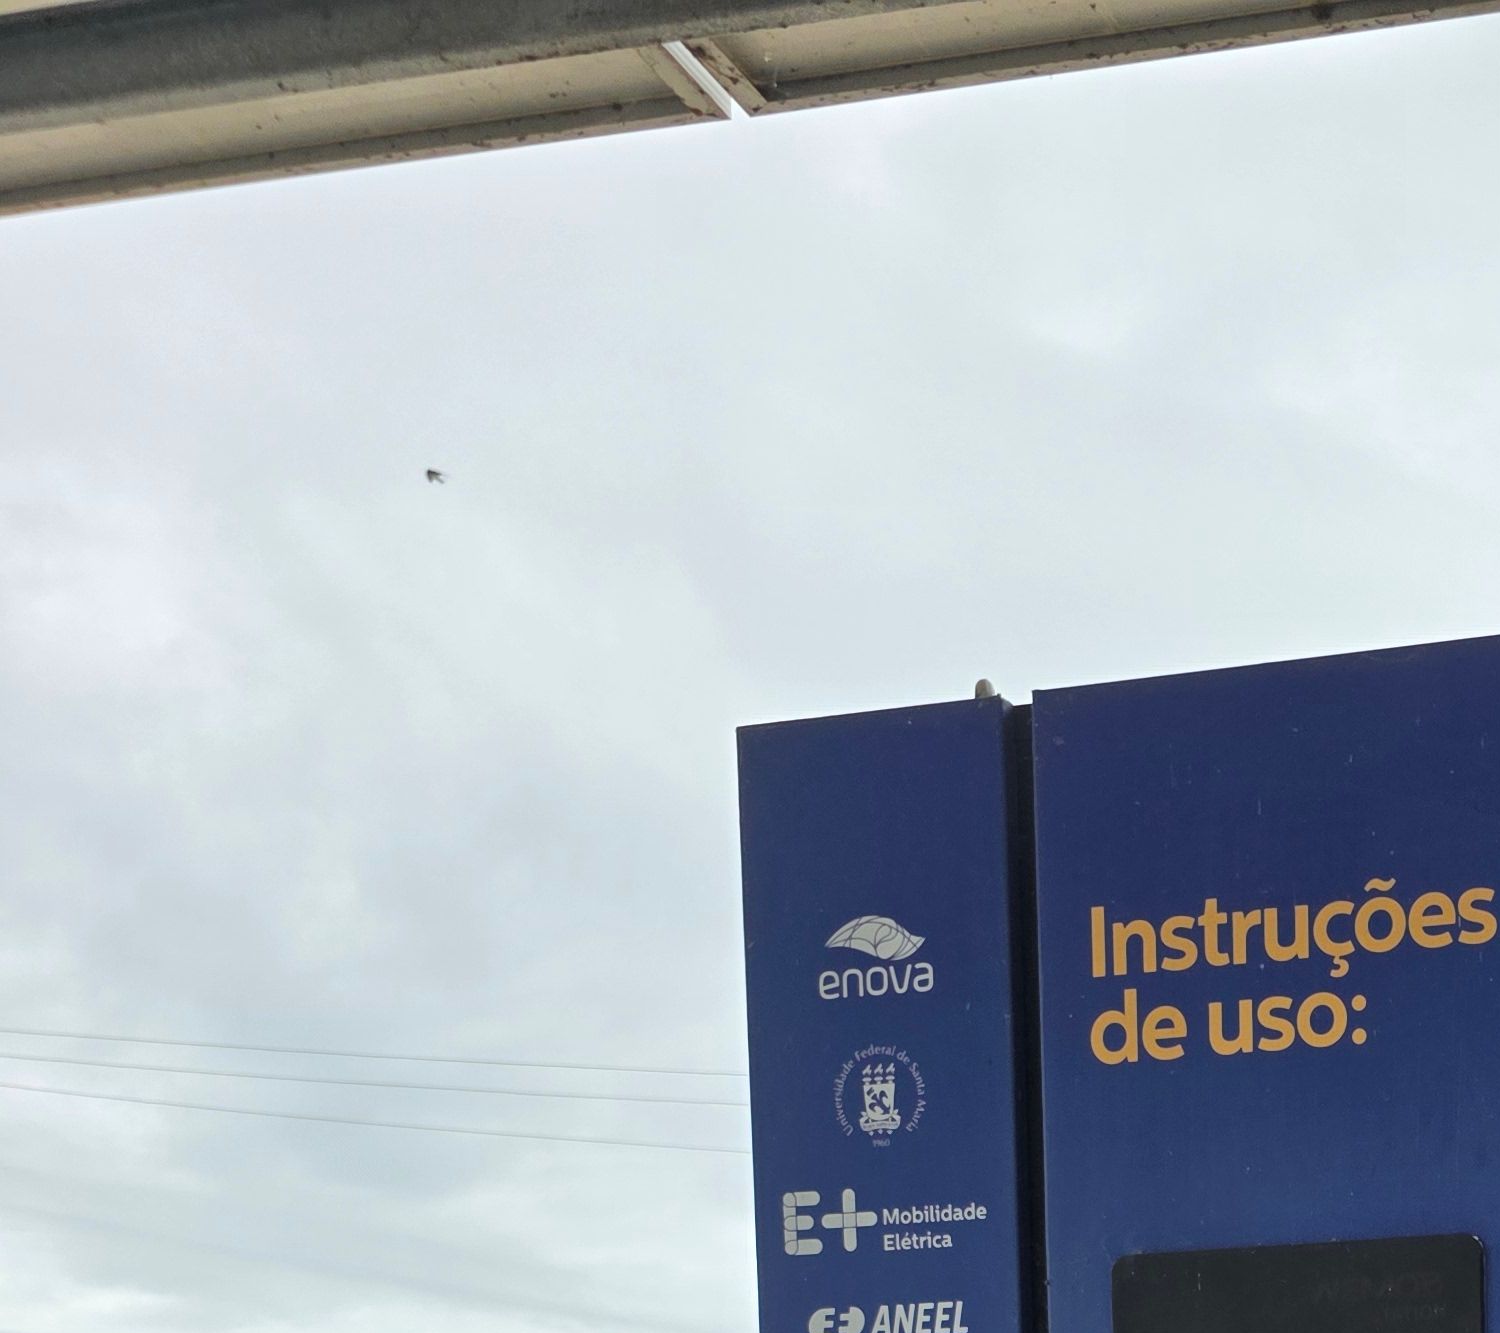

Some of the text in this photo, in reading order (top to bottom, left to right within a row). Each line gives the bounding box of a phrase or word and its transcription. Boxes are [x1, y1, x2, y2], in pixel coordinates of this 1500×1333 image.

[1090, 878, 1498, 978] Instruções
[818, 962, 934, 1000] enova
[1090, 988, 1368, 1066] de uso:
[854, 1043, 897, 1062] Federal
[896, 1050, 910, 1066] de
[908, 1062, 926, 1096] Santa
[905, 1099, 926, 1132] Maria
[882, 1202, 988, 1226] Mobilidade
[883, 1233, 953, 1251] Elétrica
